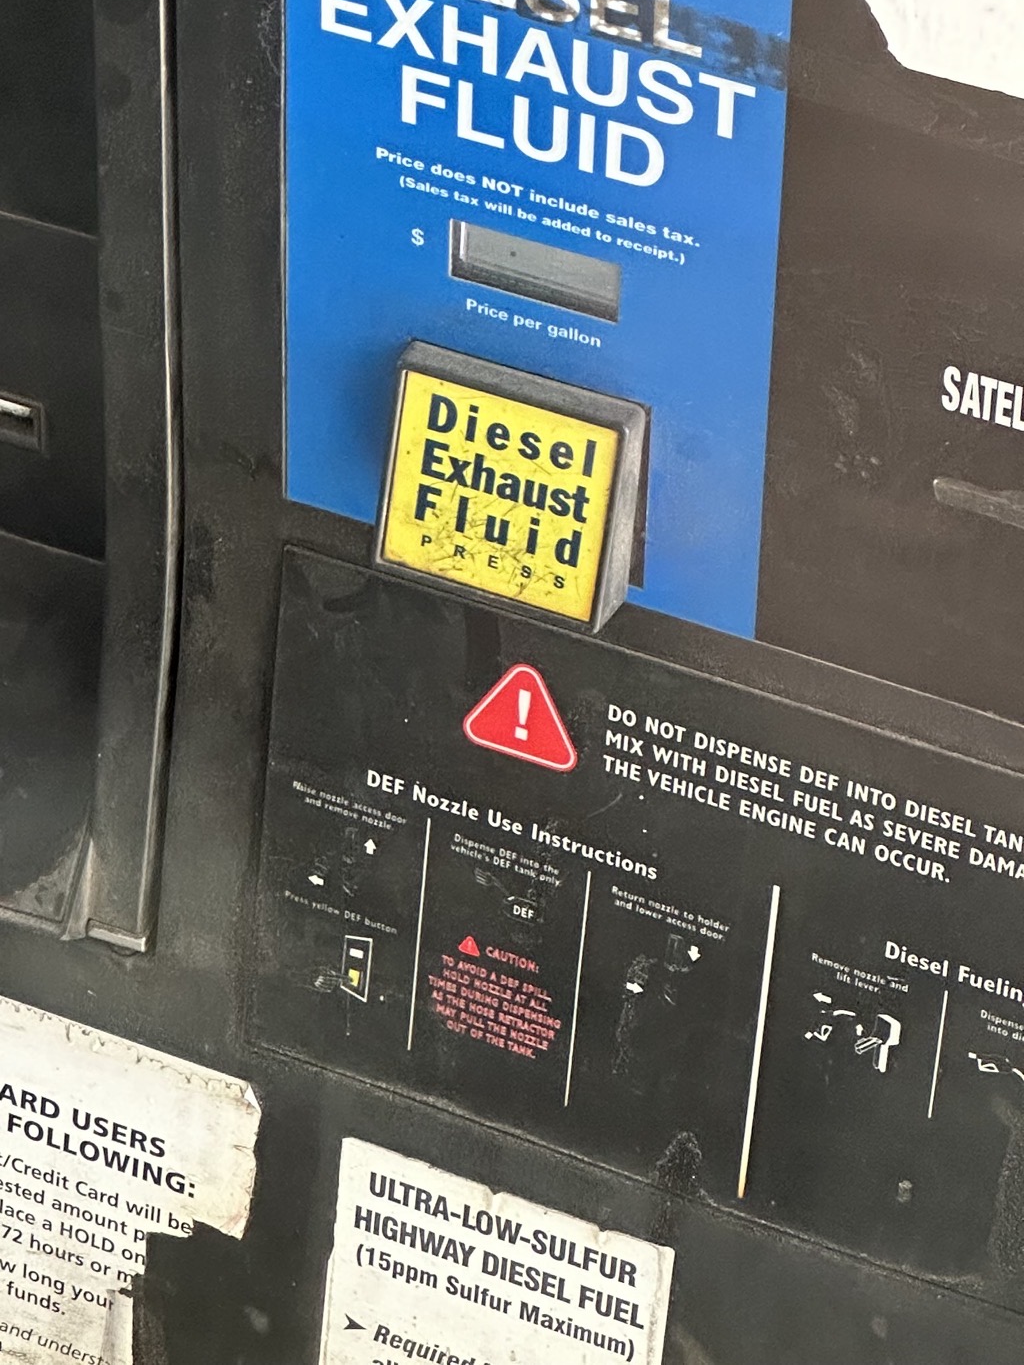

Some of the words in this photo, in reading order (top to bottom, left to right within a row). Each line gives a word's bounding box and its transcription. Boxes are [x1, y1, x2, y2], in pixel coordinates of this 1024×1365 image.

[402, 65, 664, 186] FLUID
[376, 147, 424, 170] Price
[431, 164, 476, 184] does
[482, 176, 524, 197] NOT
[530, 189, 599, 218] include
[606, 214, 656, 234] sales
[663, 227, 700, 247] tax.
[400, 176, 448, 197] (Sales
[454, 191, 478, 206] tax
[485, 201, 512, 215] will
[517, 208, 536, 221] be
[542, 217, 590, 237] added
[596, 231, 612, 243] to
[617, 238, 685, 265] receipt.)
[411, 228, 424, 246] $
[466, 299, 508, 321] Price
[514, 315, 542, 329] per
[548, 325, 600, 347] gallon
[427, 394, 597, 478] Diesel
[421, 438, 590, 523] Exhaust
[414, 483, 583, 568] Fluid
[420, 535, 565, 589] PRESS
[606, 730, 643, 756] MIX
[653, 745, 706, 776] WITH
[716, 765, 784, 801] DIESEL
[794, 791, 842, 821] FUEL
[850, 810, 874, 830] AS
[883, 821, 960, 859] SEVERE
[608, 705, 636, 726] DO
[646, 717, 686, 742] NOT
[694, 732, 791, 777] DISPENSE
[800, 766, 839, 791] DEF
[847, 781, 896, 810] INTO
[905, 800, 976, 836] DIESEL
[367, 770, 404, 794] DEF
[413, 785, 478, 820] Nozzle
[488, 809, 522, 835] Use
[532, 824, 657, 879] Instructions
[603, 755, 641, 781] THE
[648, 769, 730, 811] VEHICLE
[740, 800, 816, 838] ENGINE
[824, 829, 865, 855] CAN
[875, 845, 949, 883] OCCUR.
[514, 905, 534, 918] DEF
[612, 886, 644, 903] Return
[649, 901, 679, 915] nozzle
[684, 911, 694, 920] to
[698, 915, 729, 931] holder
[485, 946, 539, 974] CAUTION:
[812, 953, 850, 972] Remove
[854, 969, 885, 984] nozzle
[887, 976, 908, 992] and
[885, 941, 948, 977] Diesel
[8, 1113, 195, 1198] FOLLOWING:
[73, 1108, 165, 1157] USERS
[42, 1219, 52, 1231] a
[60, 1222, 114, 1253] HOLD
[122, 1248, 147, 1265] on
[52, 1199, 127, 1235] amount
[76, 1181, 118, 1207] Card
[126, 1201, 160, 1223] will
[168, 1212, 194, 1239] be
[370, 1171, 636, 1286] ULTRA-LOW-SULFUR
[354, 1205, 476, 1267] HIGHWAY
[482, 1251, 570, 1303] DIESEL
[578, 1285, 644, 1329] FUEL
[357, 1244, 437, 1289] (15ppm
[446, 1276, 512, 1314] Sulfur
[520, 1301, 634, 1362] Maximum)
[373, 1324, 476, 1365] Required
